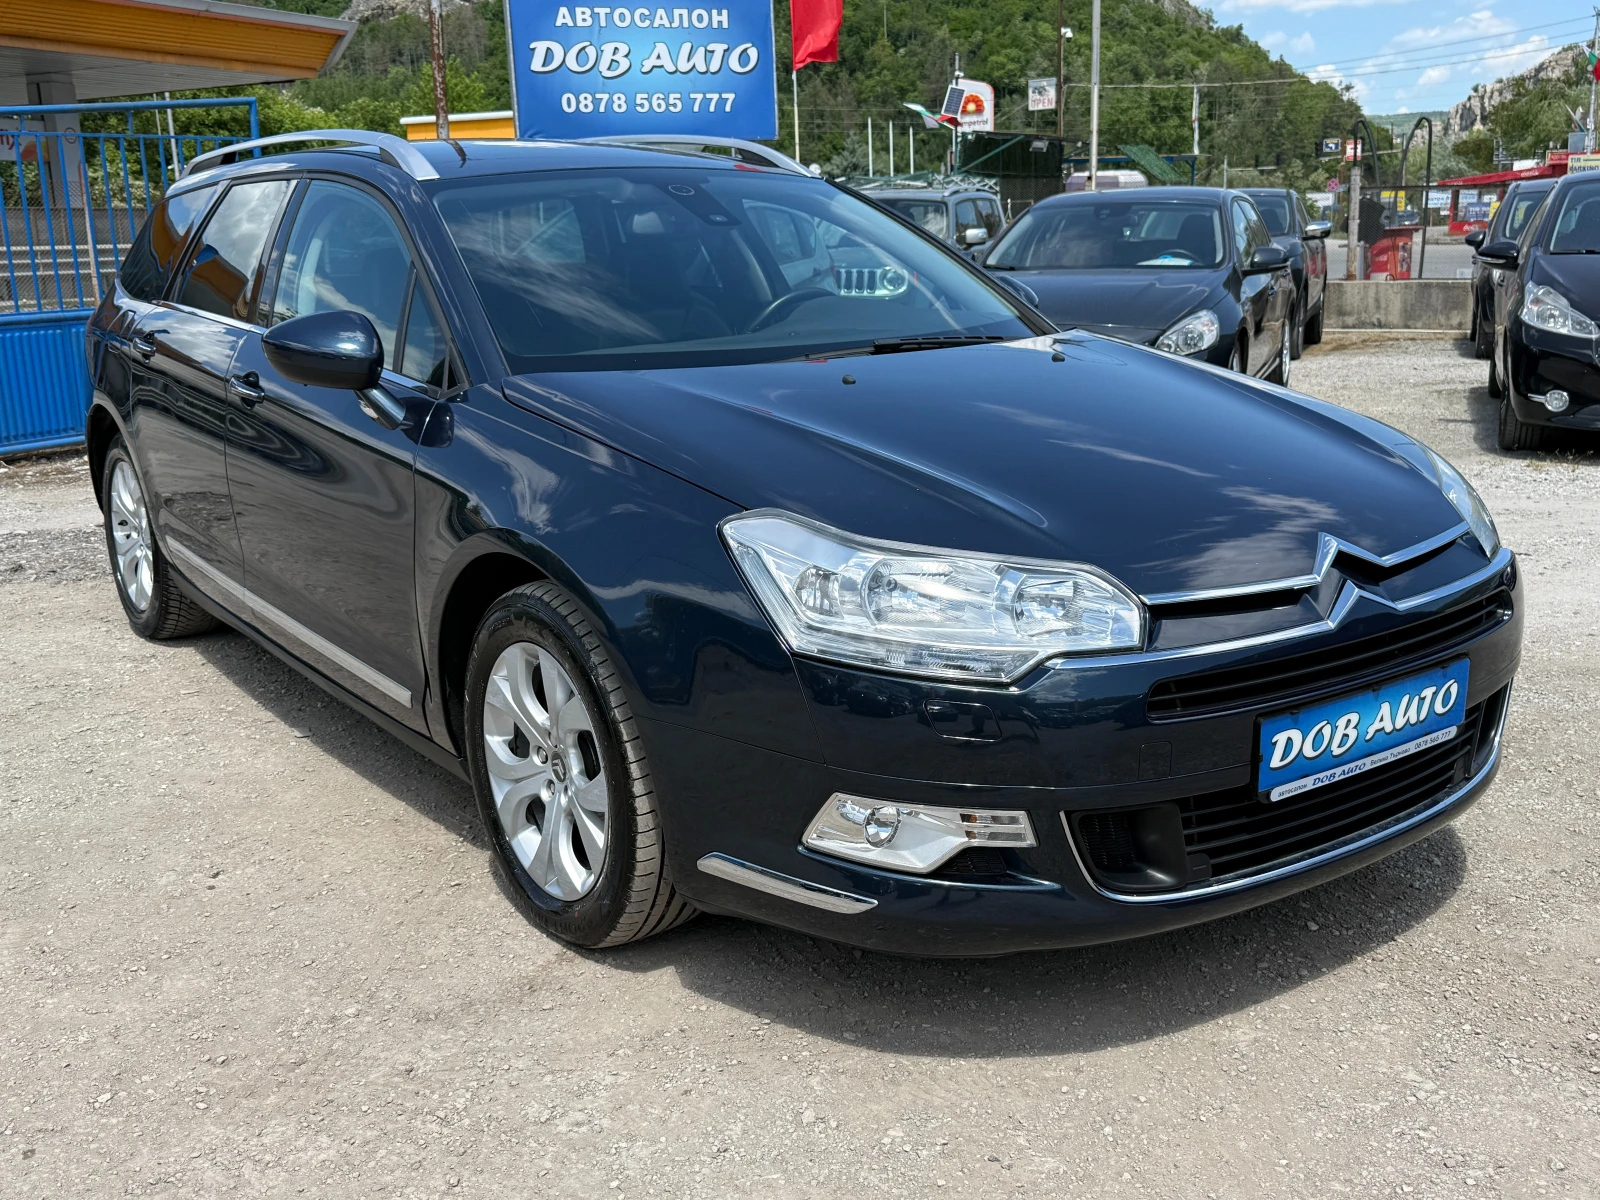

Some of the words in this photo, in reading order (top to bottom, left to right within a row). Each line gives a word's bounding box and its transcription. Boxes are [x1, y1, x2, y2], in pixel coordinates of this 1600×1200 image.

[555, 7, 729, 29] АВТОСАЛОН
[529, 40, 631, 78] DOB
[641, 41, 759, 74] AUTO
[561, 92, 628, 113] 0878
[635, 92, 683, 113] 565
[690, 93, 736, 113] 777
[1269, 712, 1360, 769] DOB
[1365, 679, 1458, 742] AUTO
[1278, 783, 1308, 797] автосалон
[1312, 772, 1336, 787] DOB
[1338, 763, 1366, 777] AUTO
[1370, 755, 1389, 766] Велико
[1414, 740, 1428, 750] 0878
[1429, 735, 1440, 745] 565
[1441, 730, 1452, 741] 777
